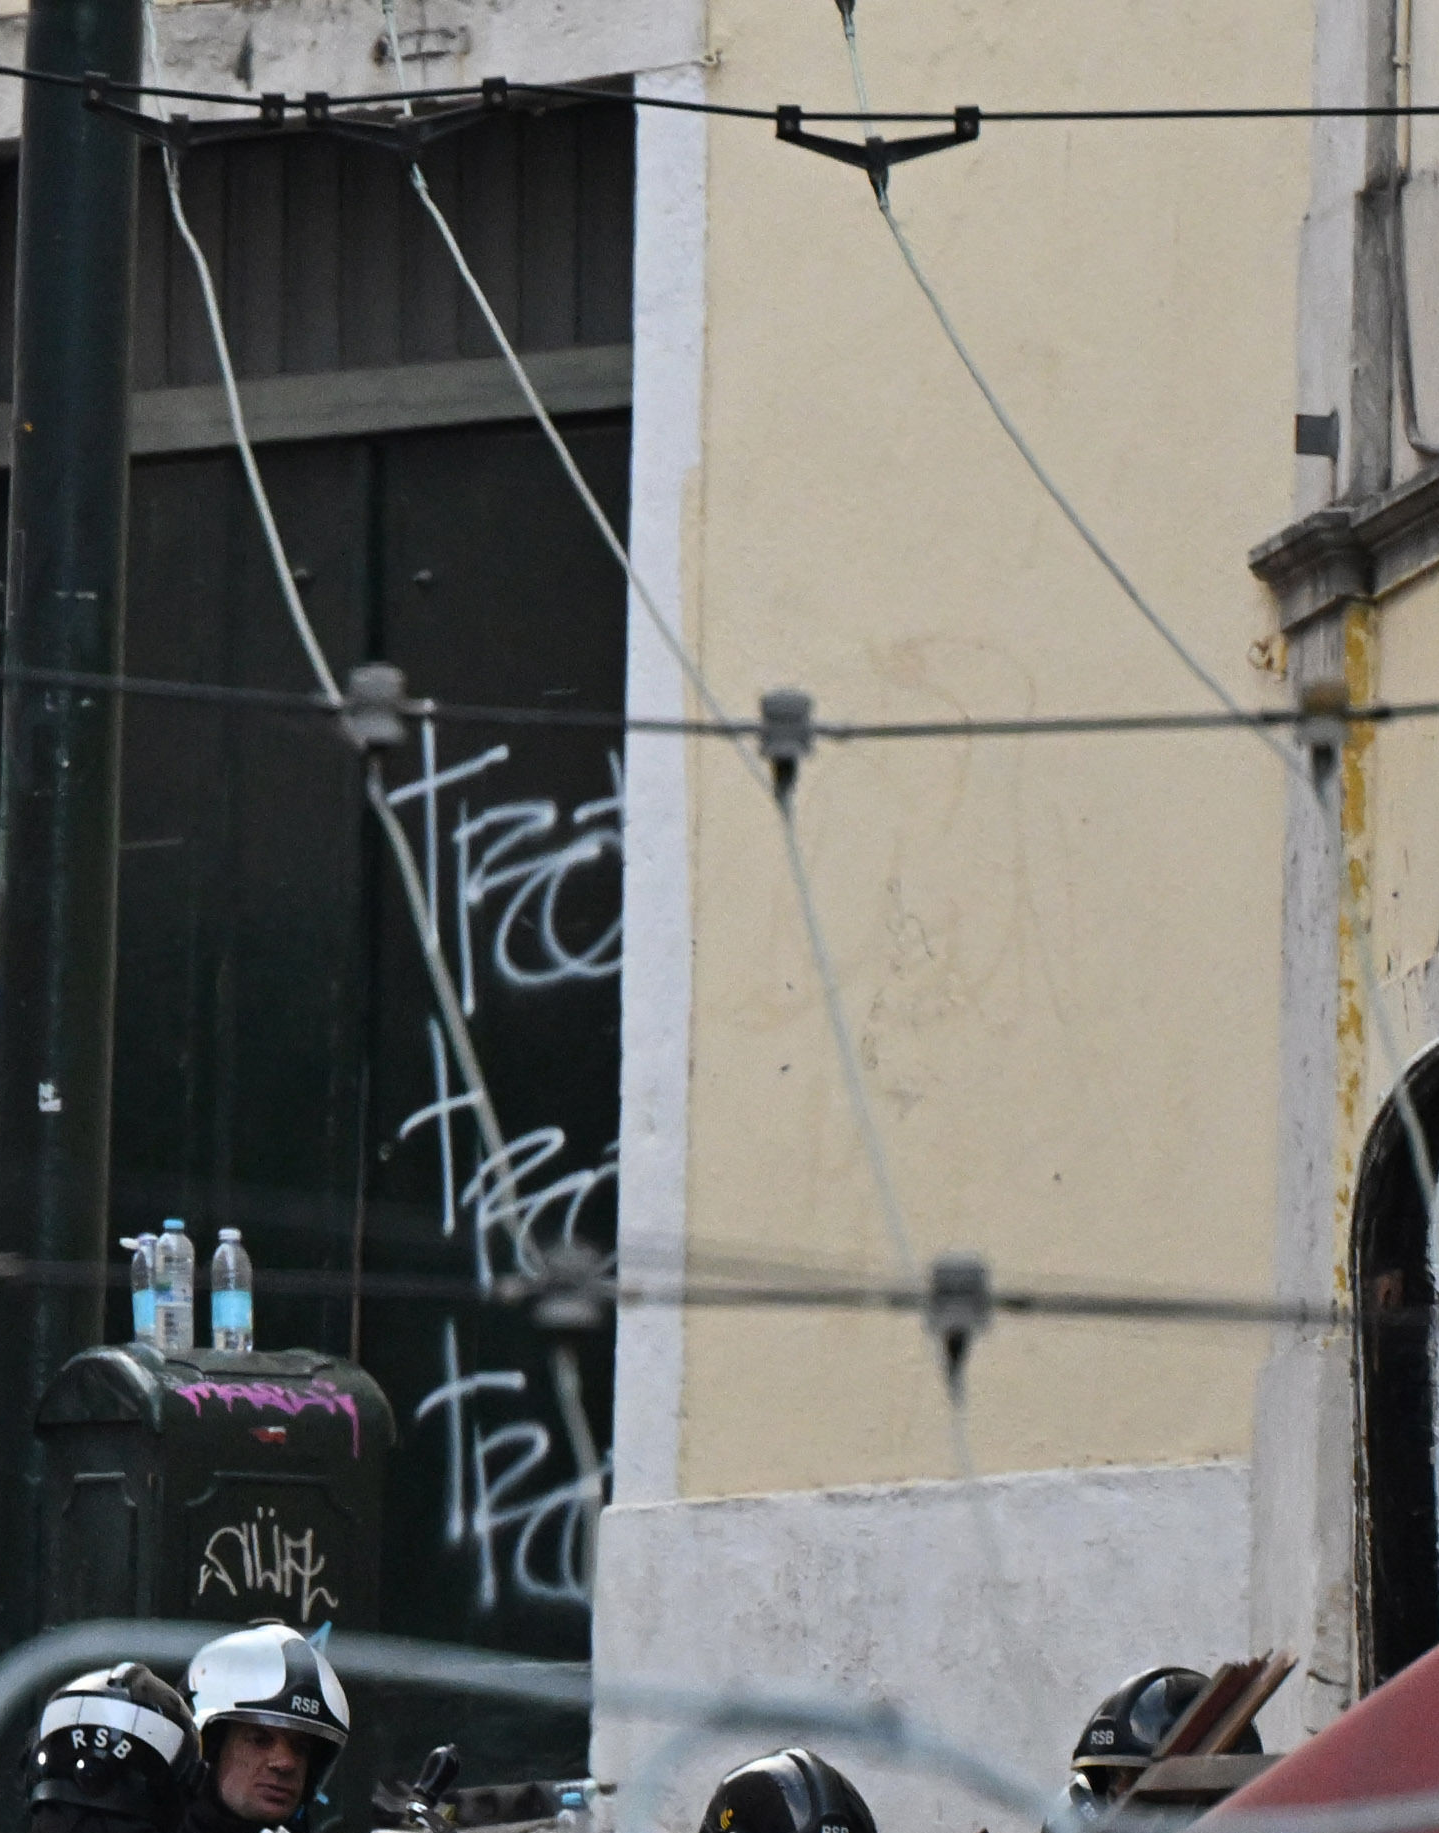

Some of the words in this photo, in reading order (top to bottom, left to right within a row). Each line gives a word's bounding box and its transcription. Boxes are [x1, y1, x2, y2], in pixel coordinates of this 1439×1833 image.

[291, 1696, 321, 1715] RSB
[71, 1727, 133, 1759] RSB
[1089, 1730, 1115, 1746] RSB
